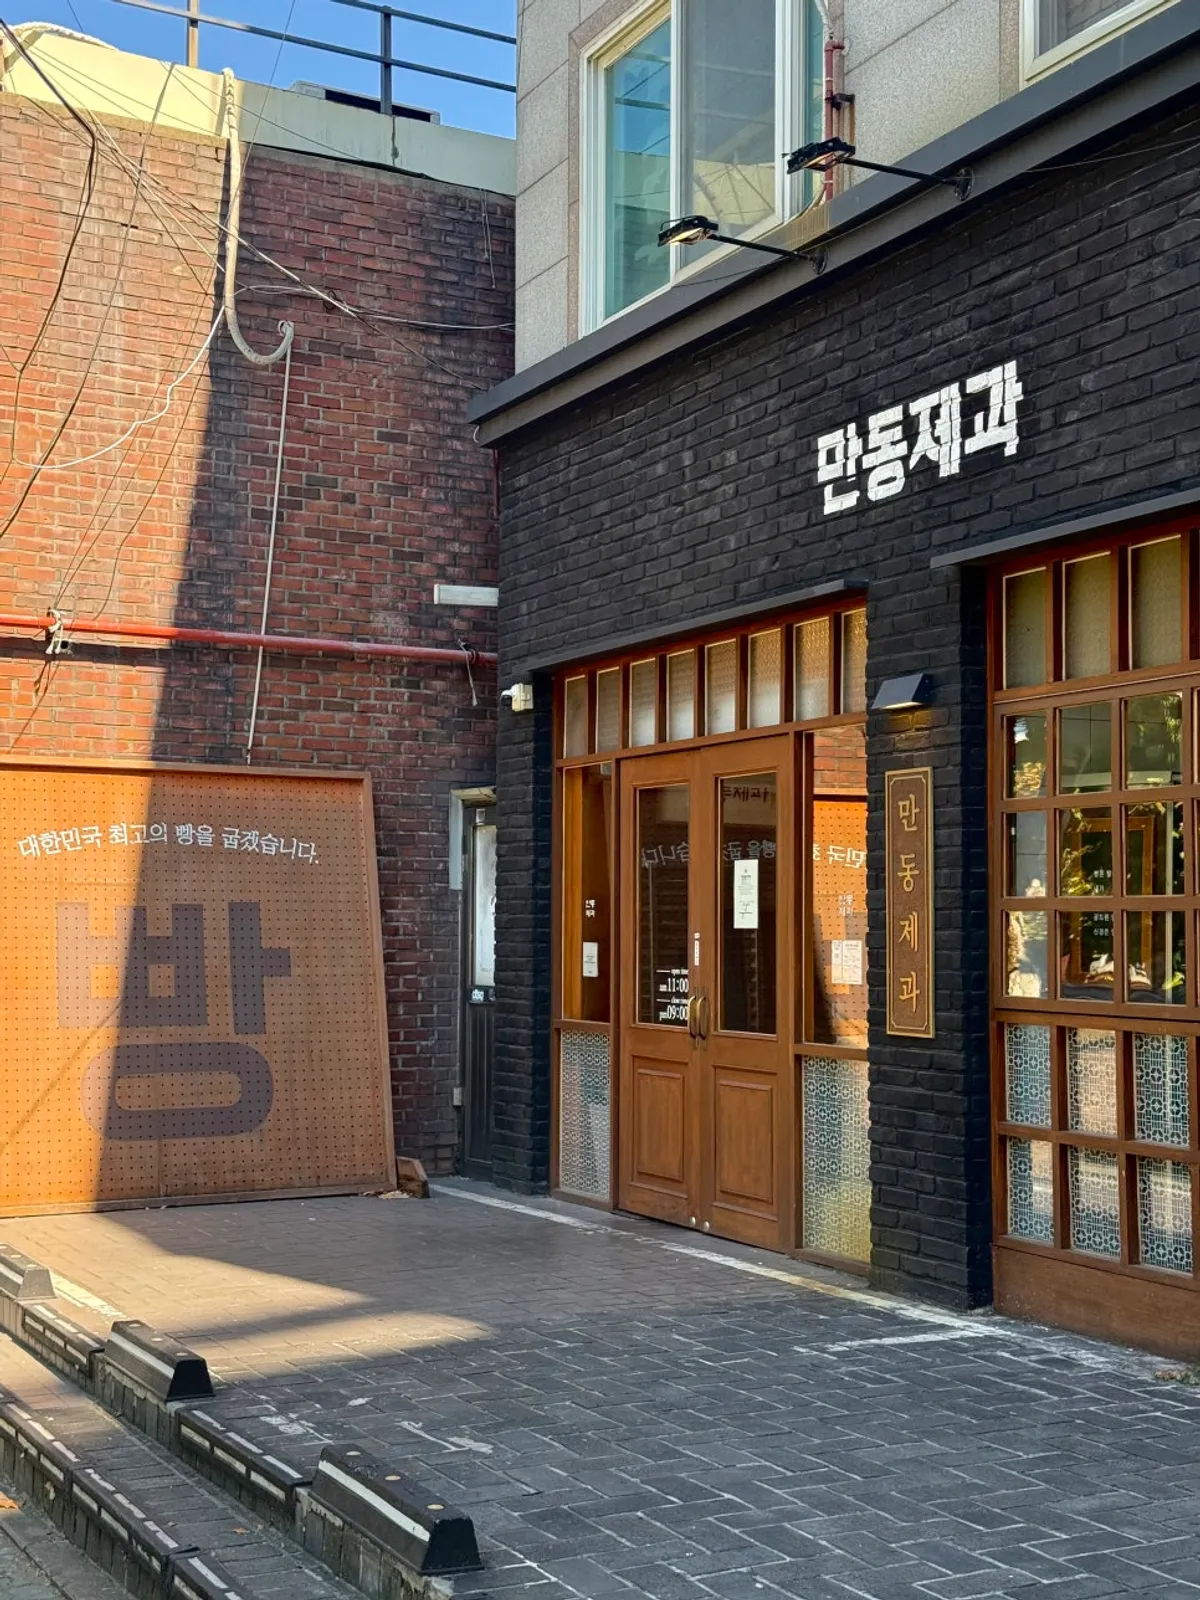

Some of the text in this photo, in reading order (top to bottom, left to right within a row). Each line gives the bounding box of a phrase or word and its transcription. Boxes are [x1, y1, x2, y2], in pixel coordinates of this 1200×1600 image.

[817, 360, 1024, 515] 만동제과
[18, 822, 320, 864] 대한민국 최고의 빵을 굽겠습니다.
[897, 793, 921, 1012] 만동제과
[56, 902, 292, 1140] 빵
